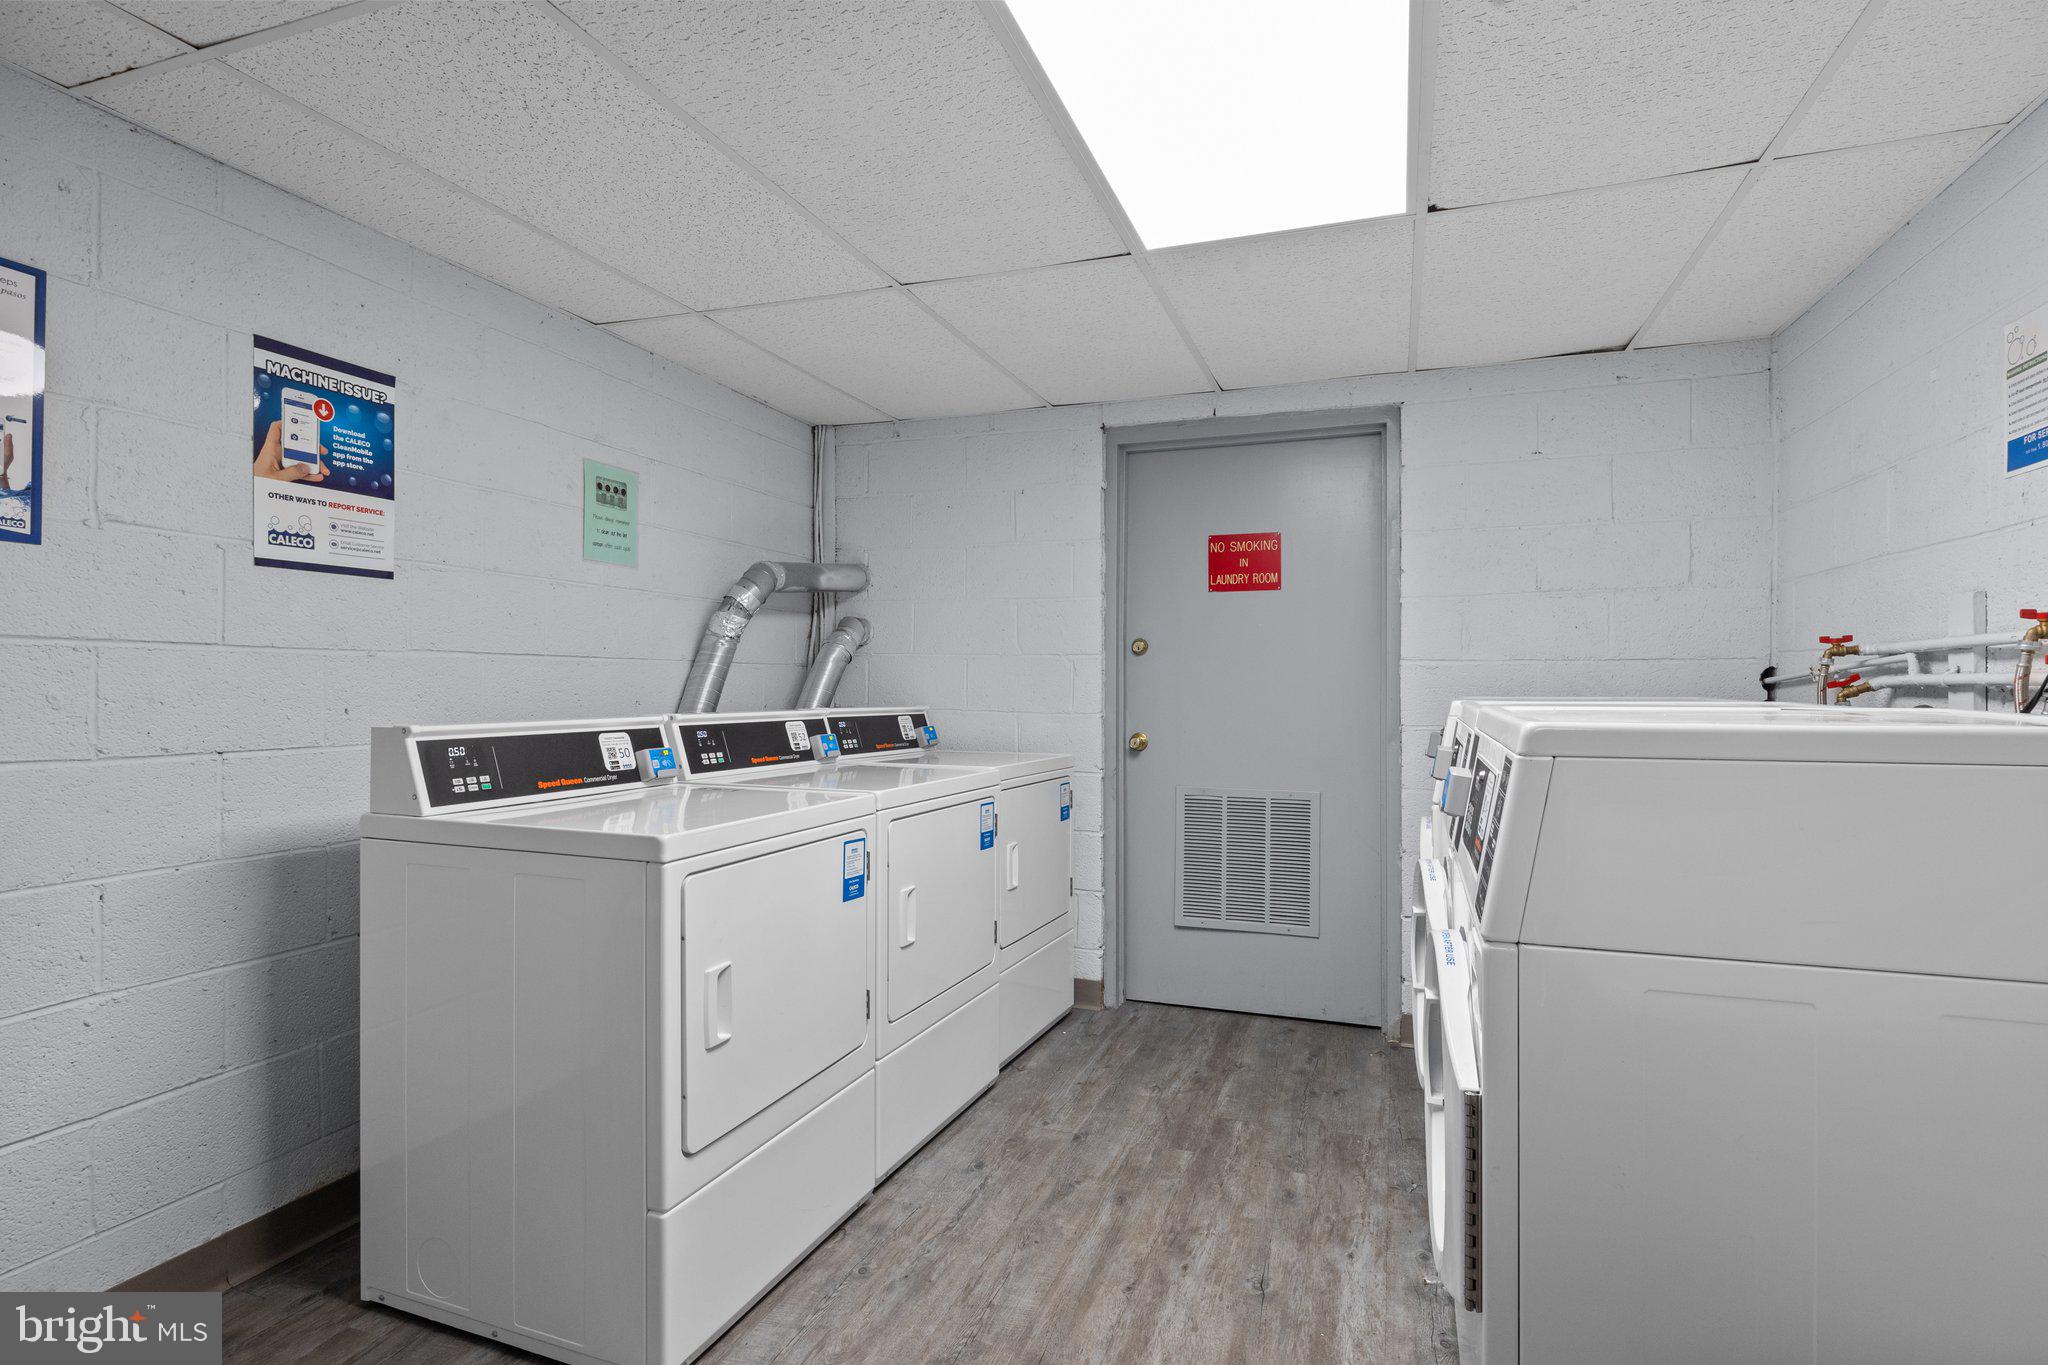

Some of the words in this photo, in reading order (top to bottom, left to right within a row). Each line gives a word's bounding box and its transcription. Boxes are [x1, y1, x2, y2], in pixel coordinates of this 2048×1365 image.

[265, 359, 338, 392] MACHINE
[339, 380, 388, 405] ISSUE?
[333, 426, 366, 439] Download
[333, 434, 345, 442] the
[345, 437, 371, 448] CALECO
[332, 442, 373, 457] CleanMobile
[332, 452, 346, 460] app
[346, 453, 362, 462] from
[363, 457, 374, 465] the
[332, 460, 346, 468] app
[346, 462, 365, 471] store.
[268, 491, 294, 502] OTHER
[295, 496, 316, 506] WAYS
[318, 499, 327, 507] TO
[328, 501, 355, 512] REPORT
[356, 506, 385, 516] SERVICE:
[269, 533, 314, 549] CALECO
[1210, 541, 1225, 553] NO
[1229, 539, 1278, 552] SMOKING
[1239, 558, 1249, 567] IN
[1210, 573, 1250, 586] LAUNDRY
[1252, 572, 1279, 584] ROOM
[618, 747, 631, 759] 50
[537, 778, 561, 790] Speed
[561, 776, 584, 786] Queen
